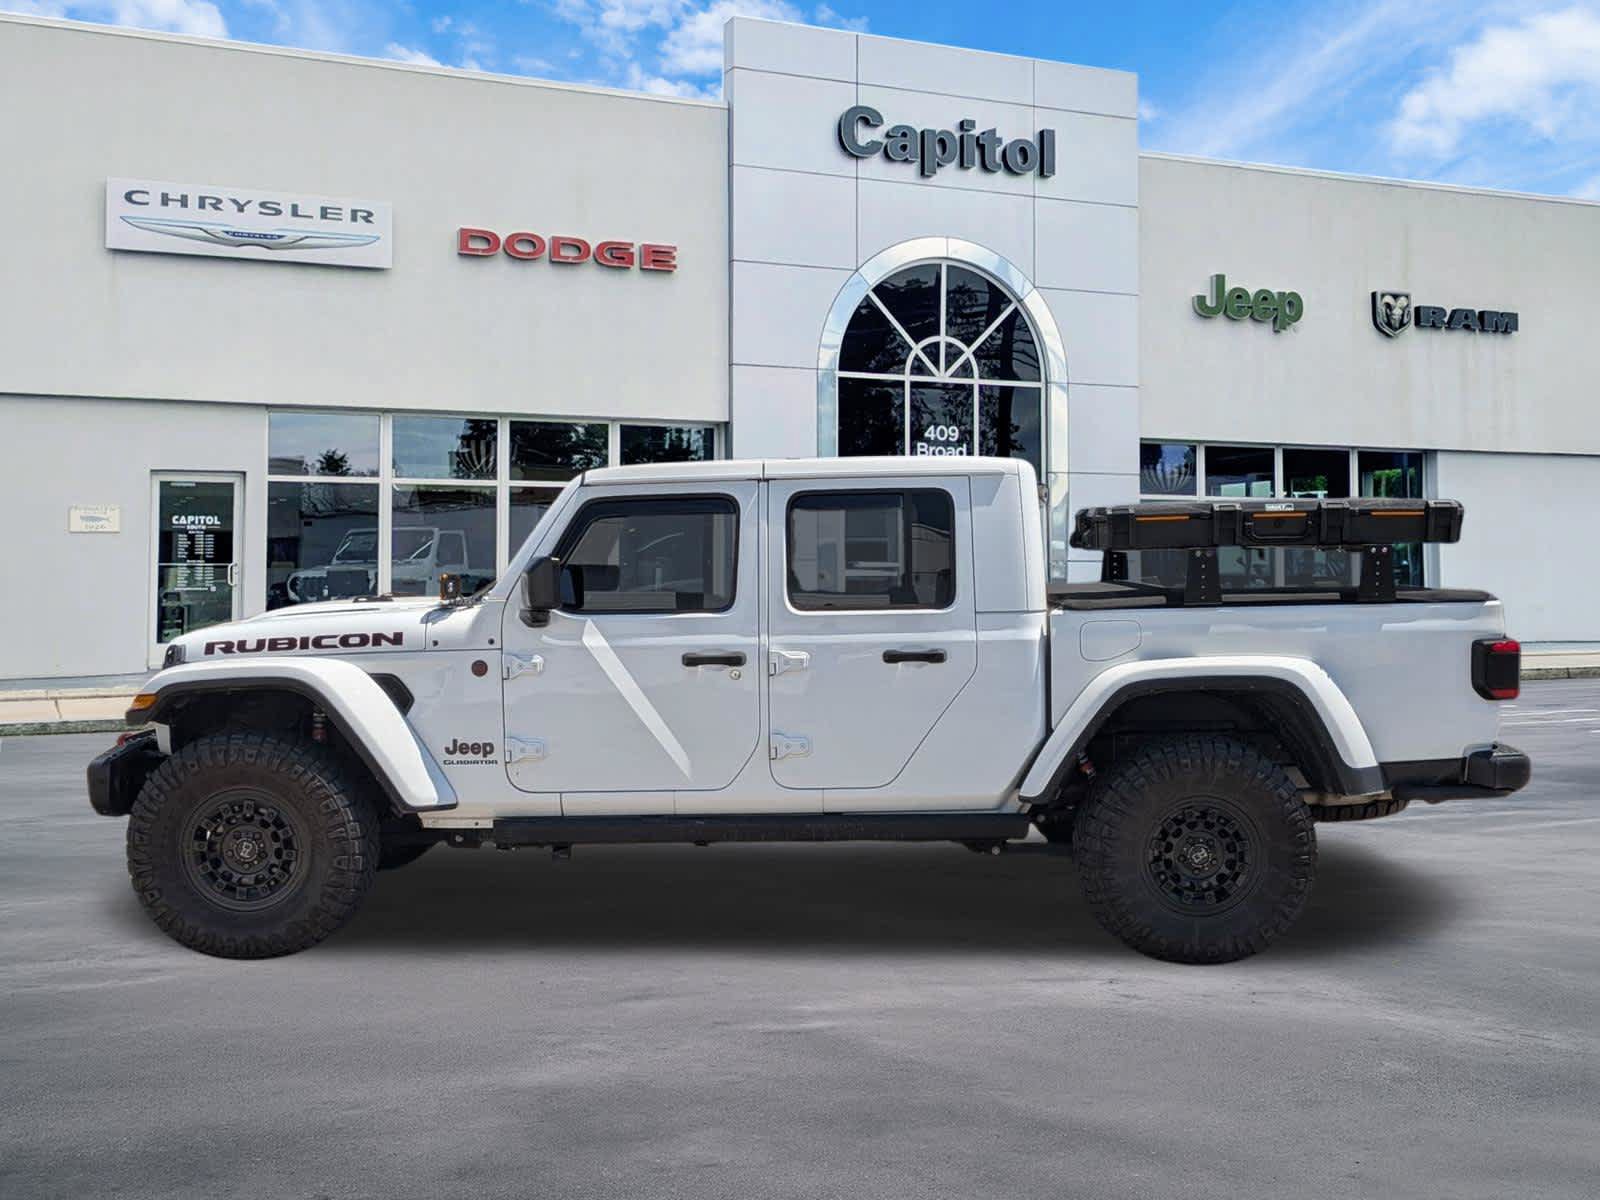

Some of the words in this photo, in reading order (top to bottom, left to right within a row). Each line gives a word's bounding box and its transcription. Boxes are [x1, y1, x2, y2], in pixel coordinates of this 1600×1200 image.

[838, 105, 1056, 177] Capitol
[123, 189, 375, 224] CHRYSLER
[457, 227, 678, 273] DODGE
[1192, 273, 1304, 333] Jeep
[1414, 305, 1519, 334] RAM
[924, 425, 959, 441] 409
[917, 442, 967, 456] Broad
[172, 515, 221, 524] CAPITOL
[204, 632, 403, 655] RUBICON
[444, 738, 495, 758] Jeep
